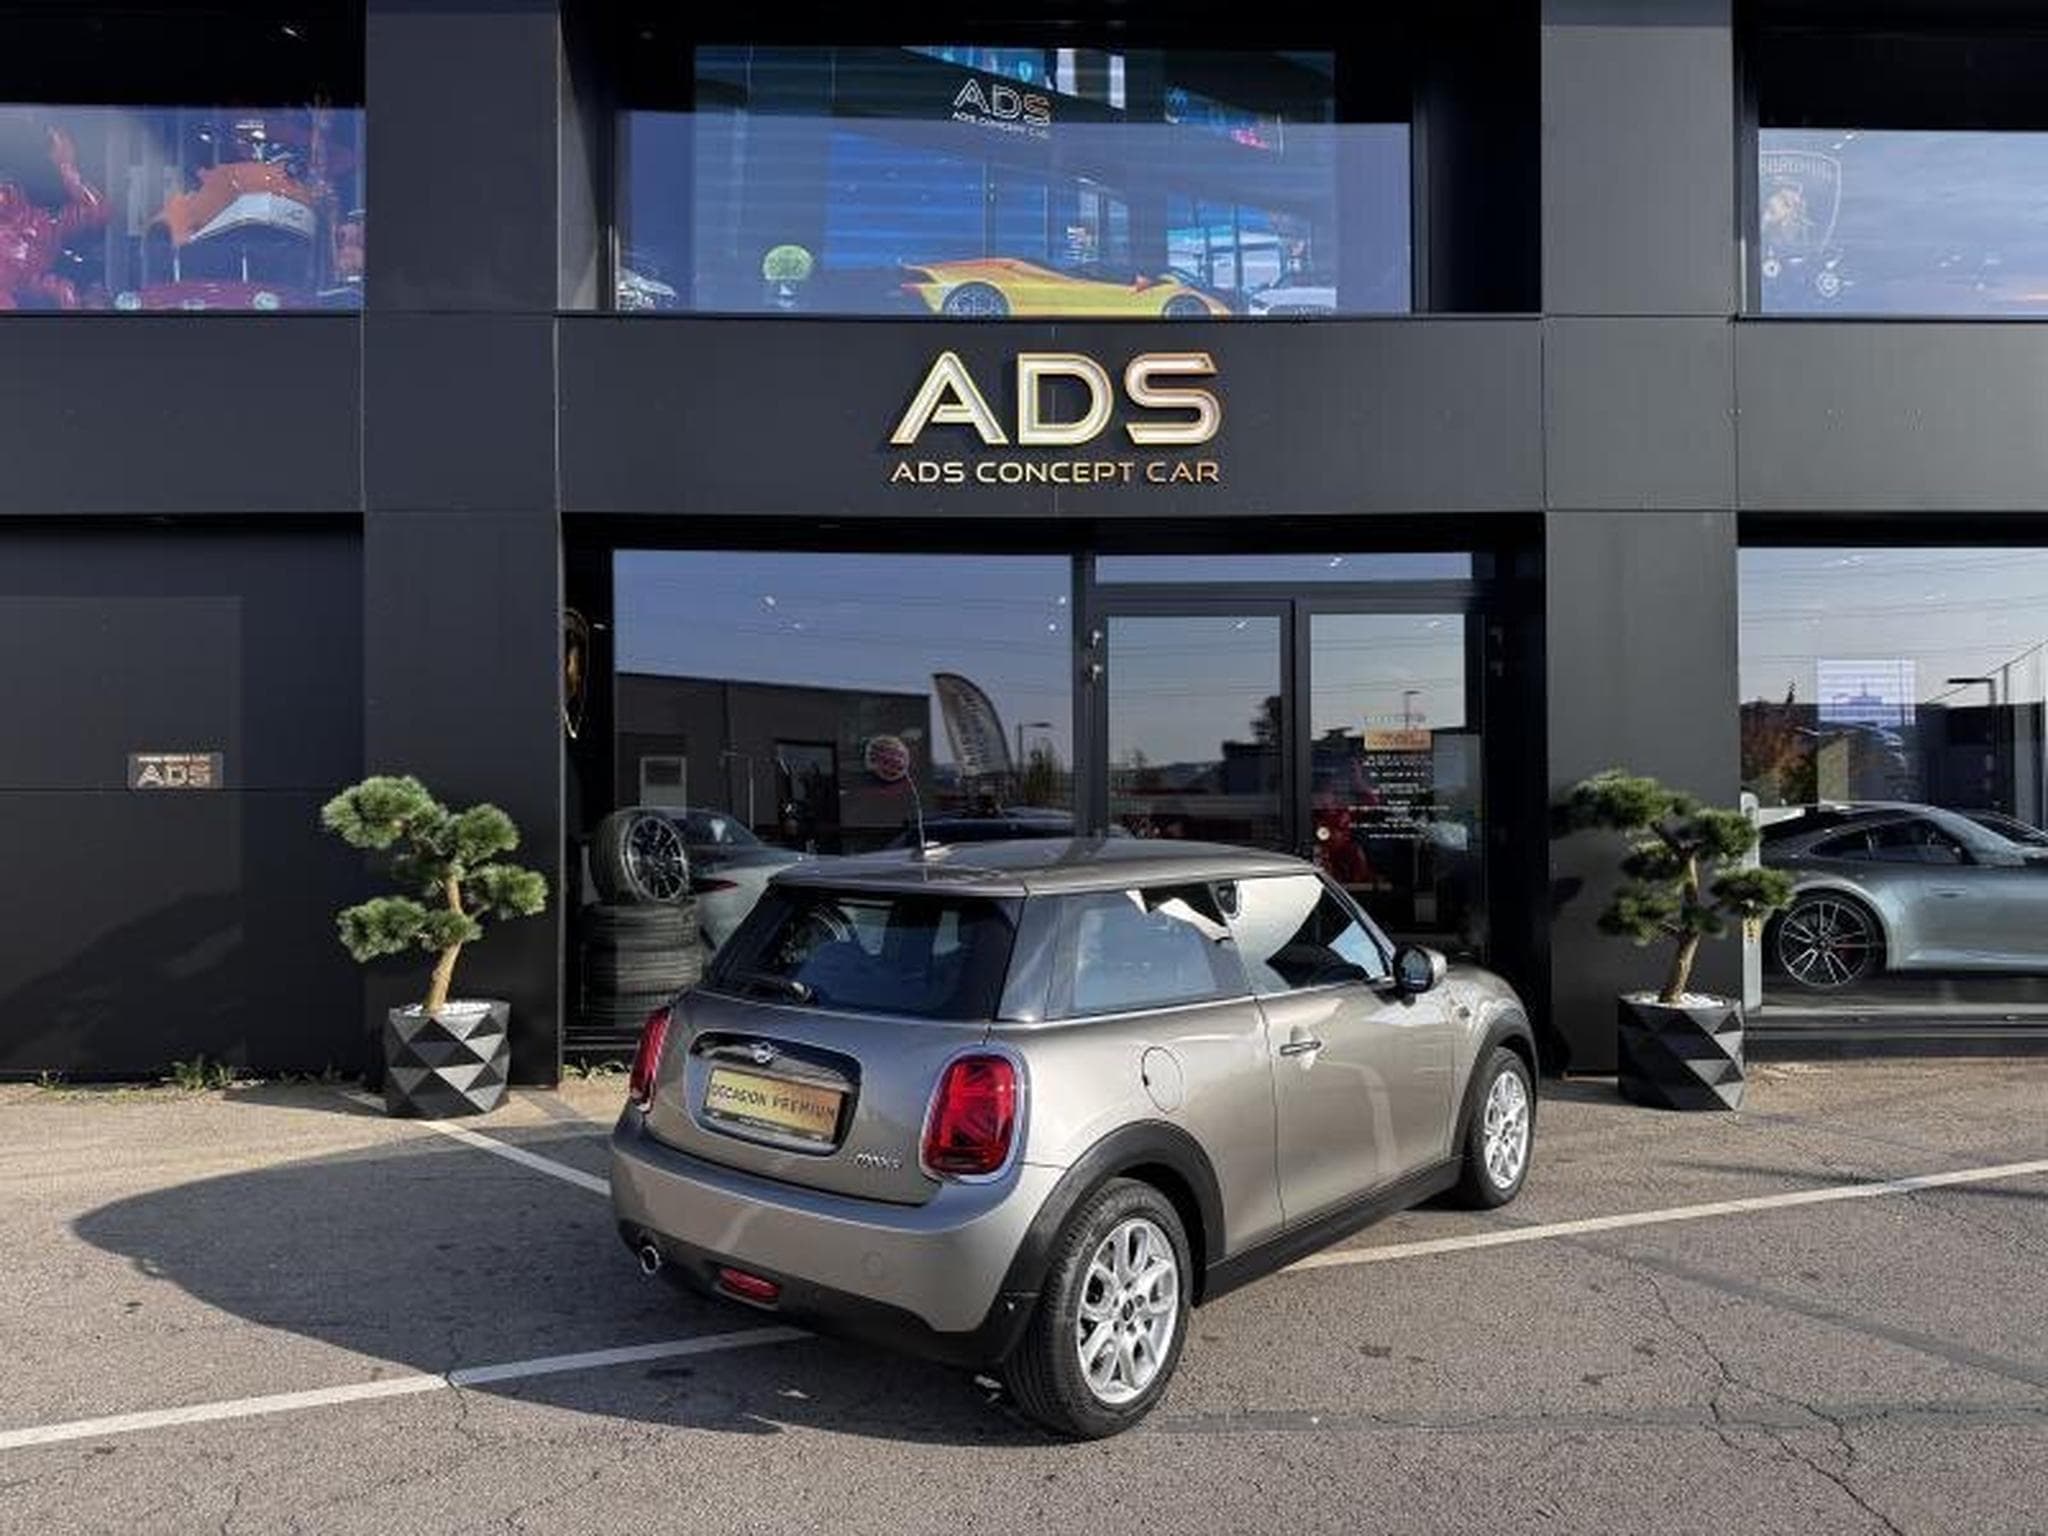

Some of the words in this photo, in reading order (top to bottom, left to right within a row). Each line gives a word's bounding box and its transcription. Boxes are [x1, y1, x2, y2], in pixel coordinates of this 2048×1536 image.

[953, 78, 1051, 126] ADS
[889, 350, 1222, 445] ADS
[890, 462, 964, 484] ADS
[977, 462, 1134, 484] CONCEPT
[1146, 462, 1220, 484] CAR
[137, 762, 211, 787] ADS
[772, 1094, 836, 1119] PREMIUM
